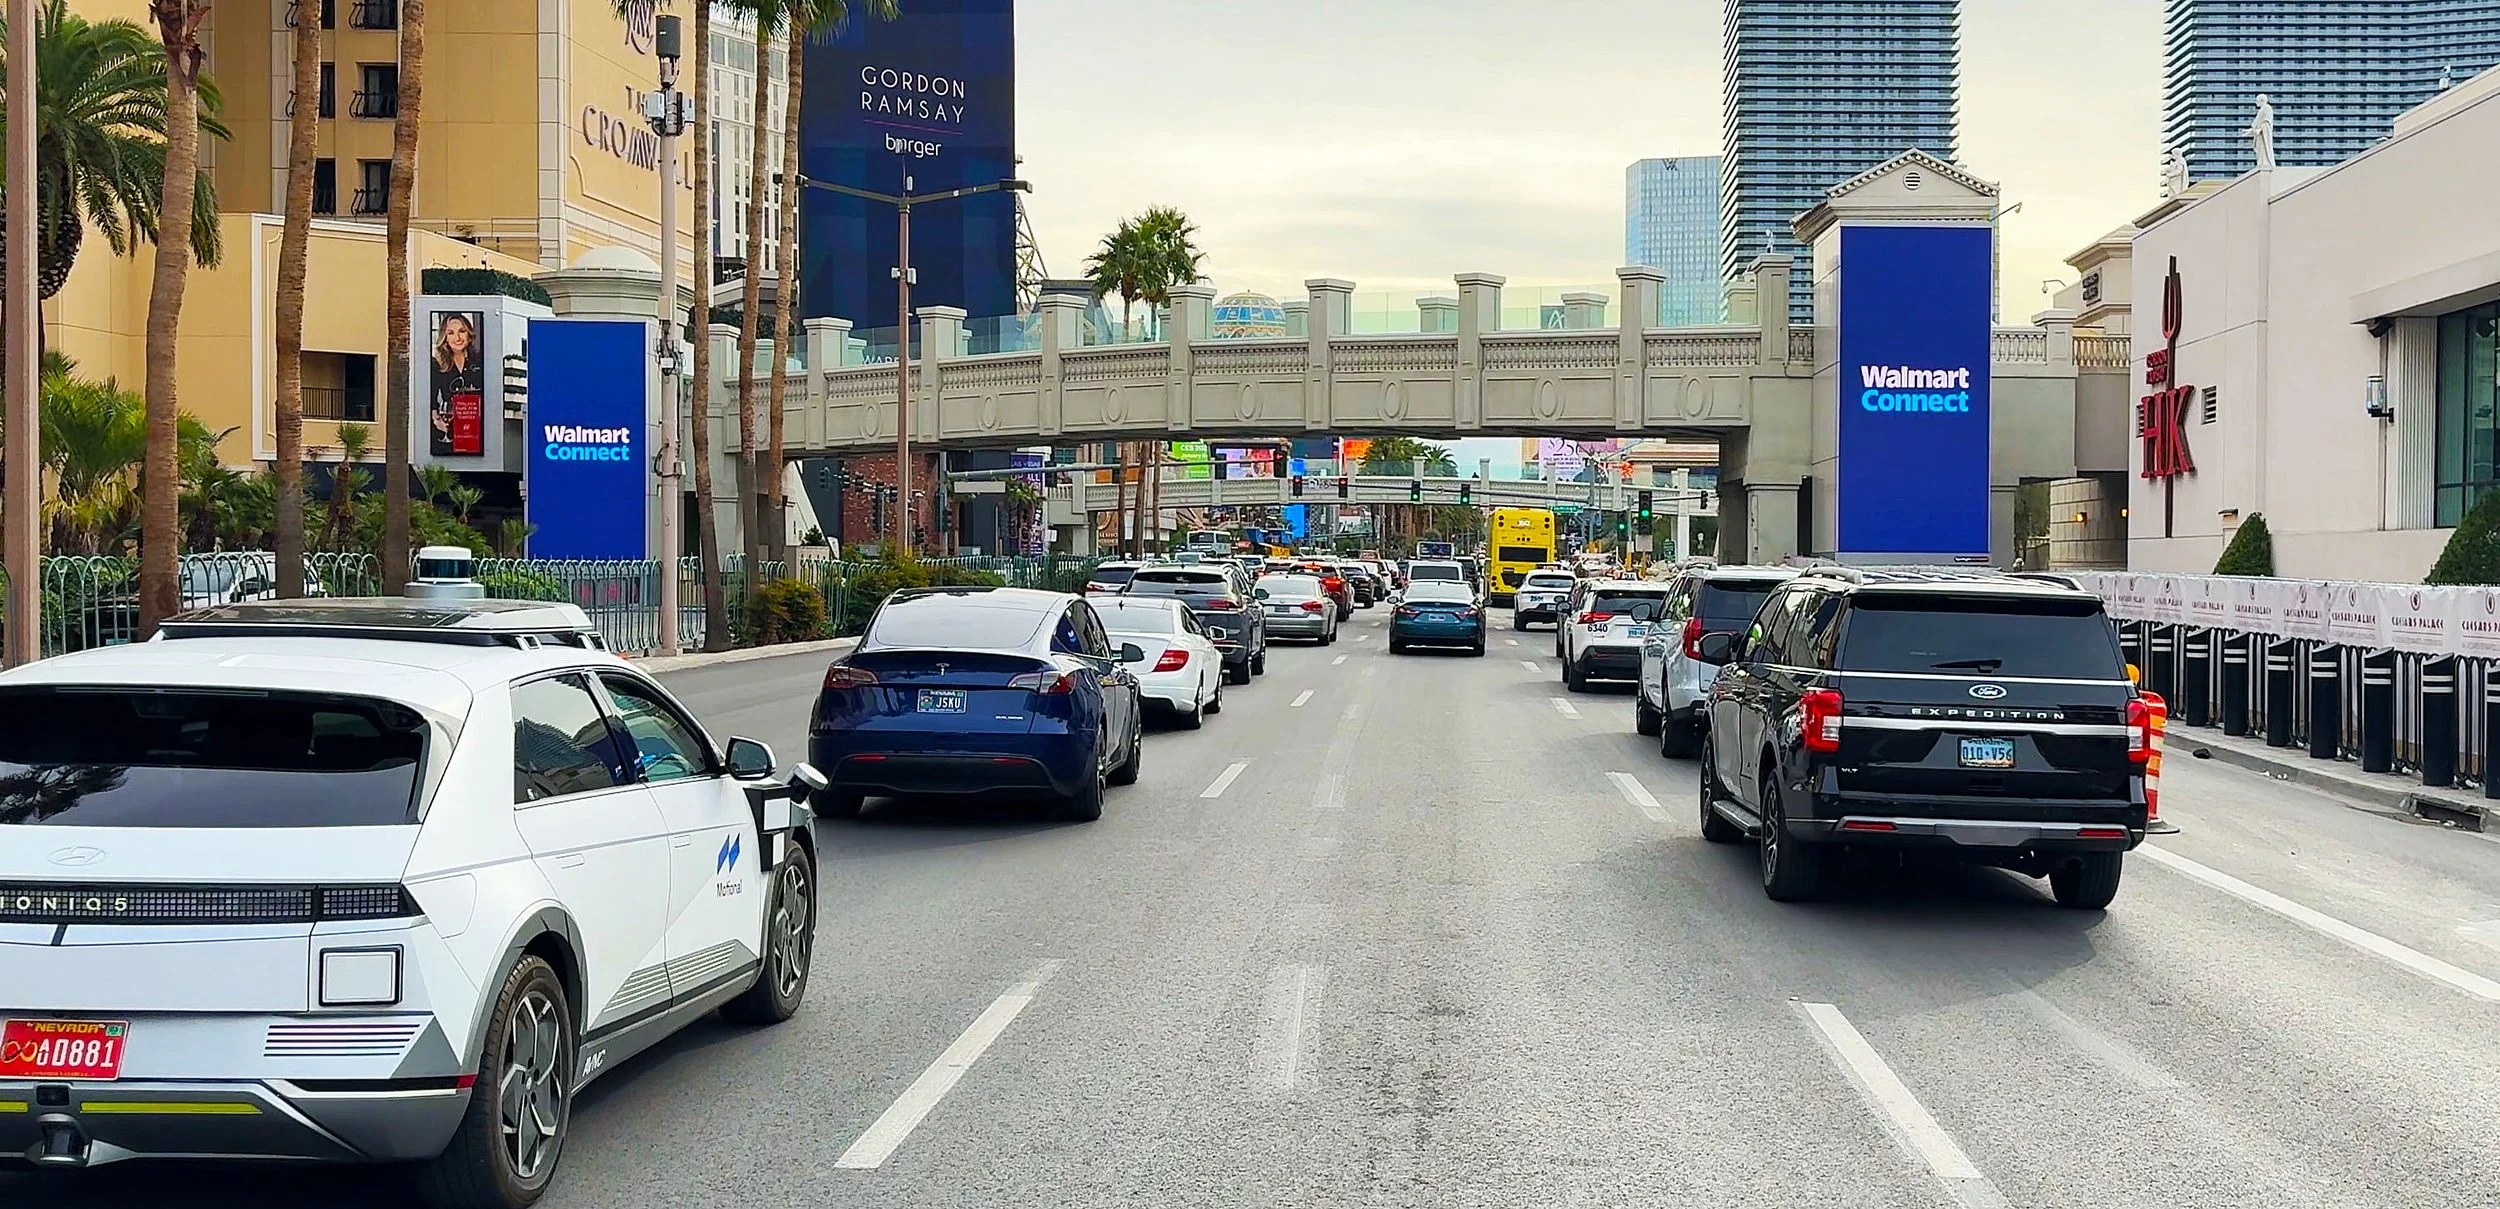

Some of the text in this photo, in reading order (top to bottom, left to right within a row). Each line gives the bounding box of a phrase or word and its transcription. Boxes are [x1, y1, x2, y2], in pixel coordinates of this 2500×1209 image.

[861, 66, 965, 99] GORDON
[861, 91, 964, 124] RAMSAY
[1860, 365, 1970, 389] Walmart
[1861, 389, 1969, 413] Connect
[543, 425, 630, 444] Walmart
[2141, 384, 2195, 478] HK
[544, 443, 630, 461] Connect
[2353, 613, 2377, 625] PALACE
[2391, 616, 2444, 630] CAESARS PALACE
[2461, 620, 2492, 633] CAESARS
[1587, 623, 1608, 633] 6340
[936, 697, 961, 709] JSKU
[1911, 707, 2065, 720] EXPEDITION
[716, 878, 743, 898] Motional
[0, 895, 128, 912] IONIQ 5
[34, 1022, 99, 1034] NEVADA
